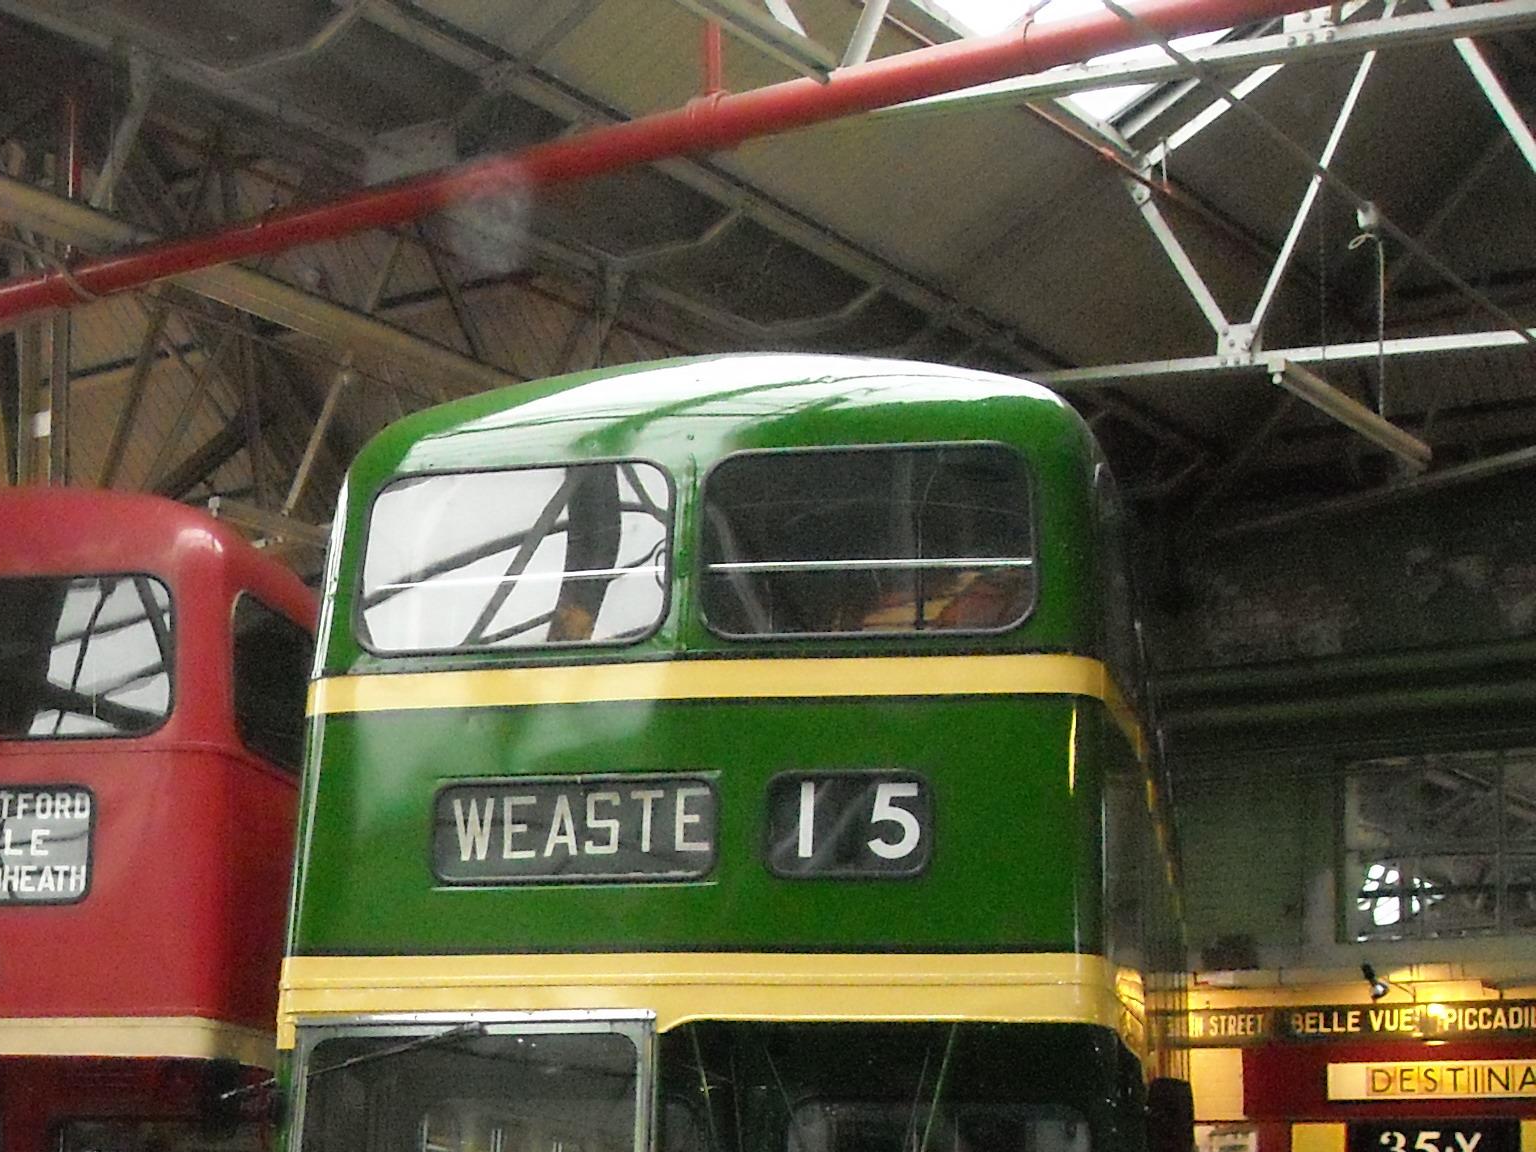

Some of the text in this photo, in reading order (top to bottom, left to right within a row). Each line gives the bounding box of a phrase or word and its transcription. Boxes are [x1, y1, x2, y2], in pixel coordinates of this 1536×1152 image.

[453, 787, 710, 861] WEASTE
[1209, 1014, 1264, 1036] STREET
[1291, 1010, 1361, 1034] BELLE
[1369, 1008, 1414, 1031] VUE
